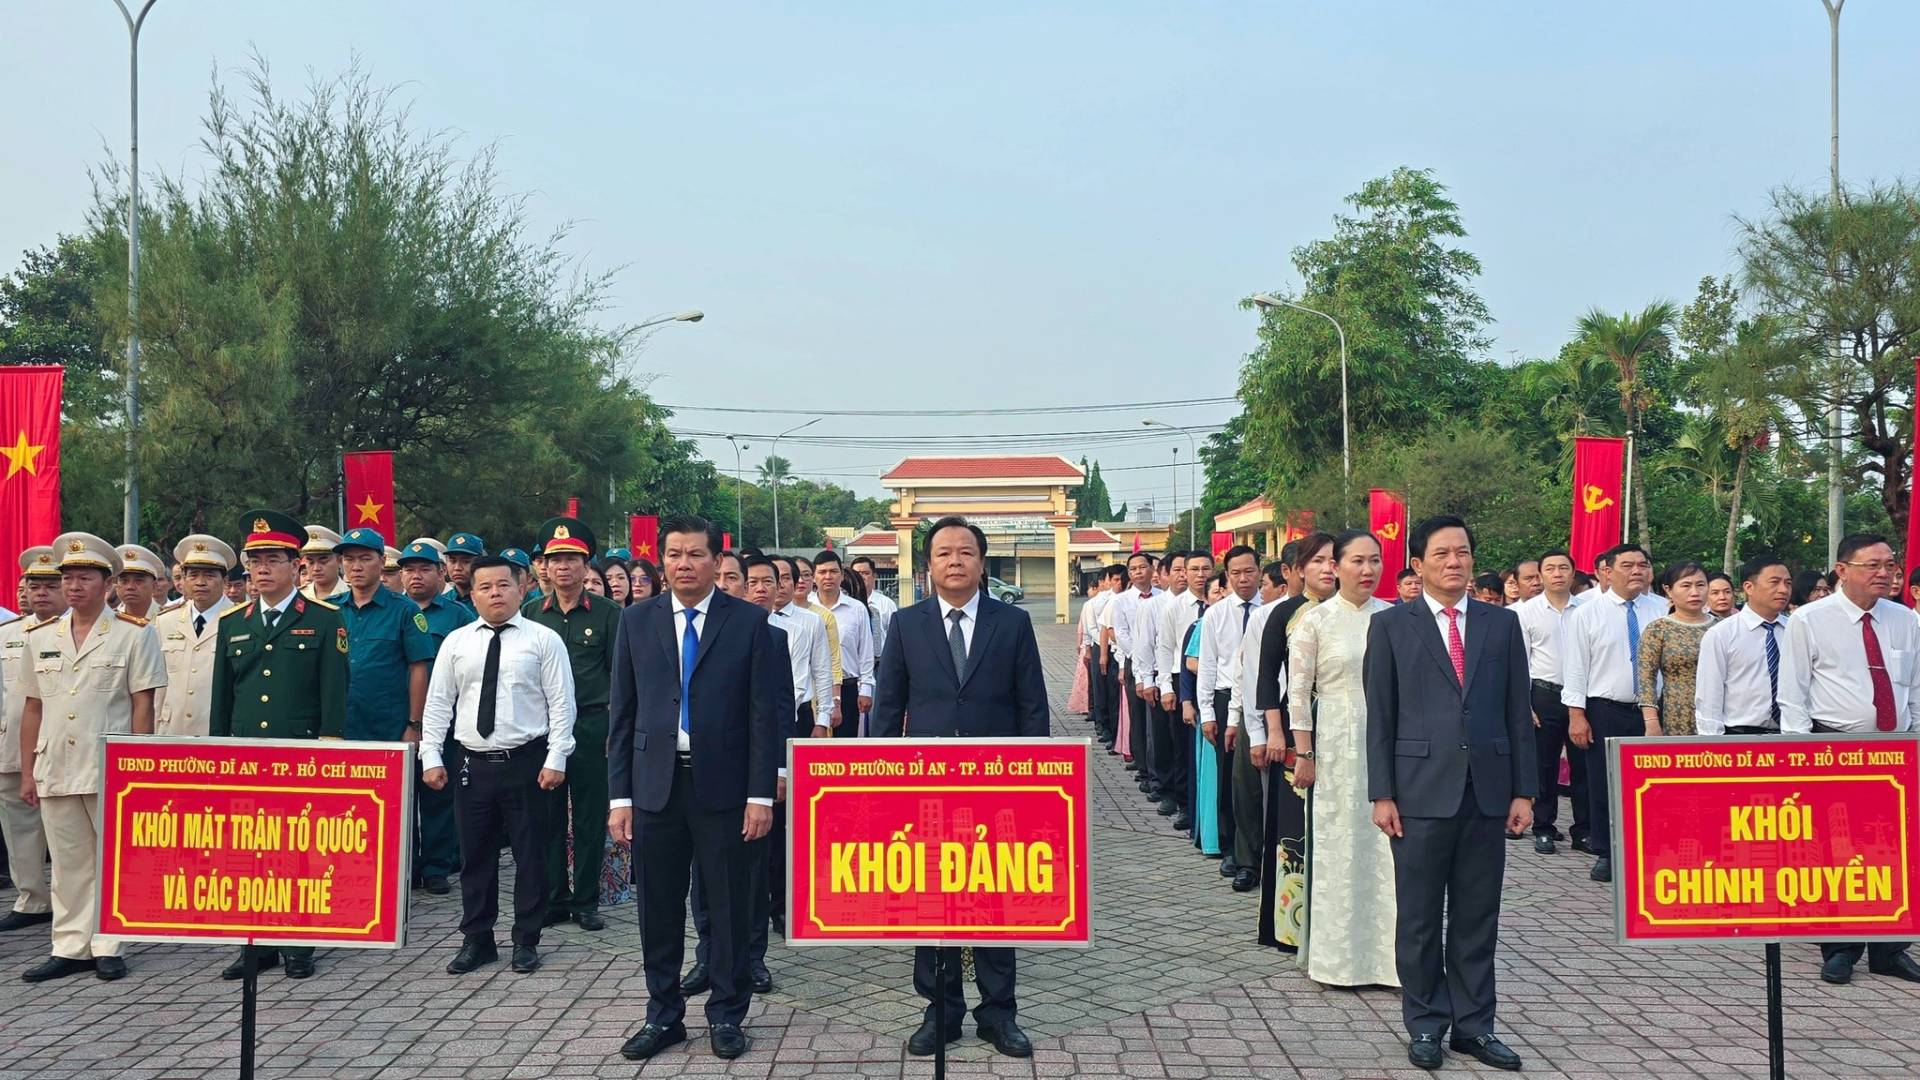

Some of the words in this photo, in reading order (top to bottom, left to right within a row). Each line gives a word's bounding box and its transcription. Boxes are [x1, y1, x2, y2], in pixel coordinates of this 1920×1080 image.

[118, 758, 155, 771] UBND
[160, 757, 216, 773] PHƯỜNG
[220, 759, 235, 774] DĨ
[239, 762, 258, 775] AN
[272, 763, 292, 775] TP.
[297, 757, 316, 777] HỒ
[321, 762, 346, 777] CHÍ
[350, 765, 386, 778] MINH
[809, 763, 845, 776] UBND
[850, 759, 905, 775] PHƯỜNG
[909, 759, 923, 775] DĨ
[927, 762, 946, 775] AN
[959, 762, 979, 775] TP.
[984, 755, 1003, 775] HỒ
[1008, 759, 1032, 775] CHÍ
[1037, 762, 1073, 775] MINH
[1634, 755, 1671, 768] UBND
[1676, 751, 1732, 768] PHƯỜNG
[1737, 751, 1752, 767] DĨ
[1756, 754, 1774, 766] AN
[1788, 753, 1809, 766] TP.
[1814, 746, 1833, 766] HỒ
[1839, 749, 1863, 765] CHÍ
[1868, 752, 1904, 765] MINH
[132, 800, 177, 848] KHỐI
[183, 806, 225, 856] MẶT
[231, 808, 281, 858] TRẬN
[287, 803, 312, 852] TỔ
[316, 805, 367, 856] QUỐC
[1730, 792, 1812, 841] KHỐI
[831, 824, 926, 893] KHỐI
[939, 824, 1053, 893] ĐẢNG
[1655, 861, 1764, 905] CHÍNH
[1776, 855, 1892, 907] QUYỀN
[164, 868, 187, 910] VÀ
[194, 869, 232, 911] CÁC
[238, 870, 291, 912] ĐOÀN
[297, 865, 334, 914] THỂ
